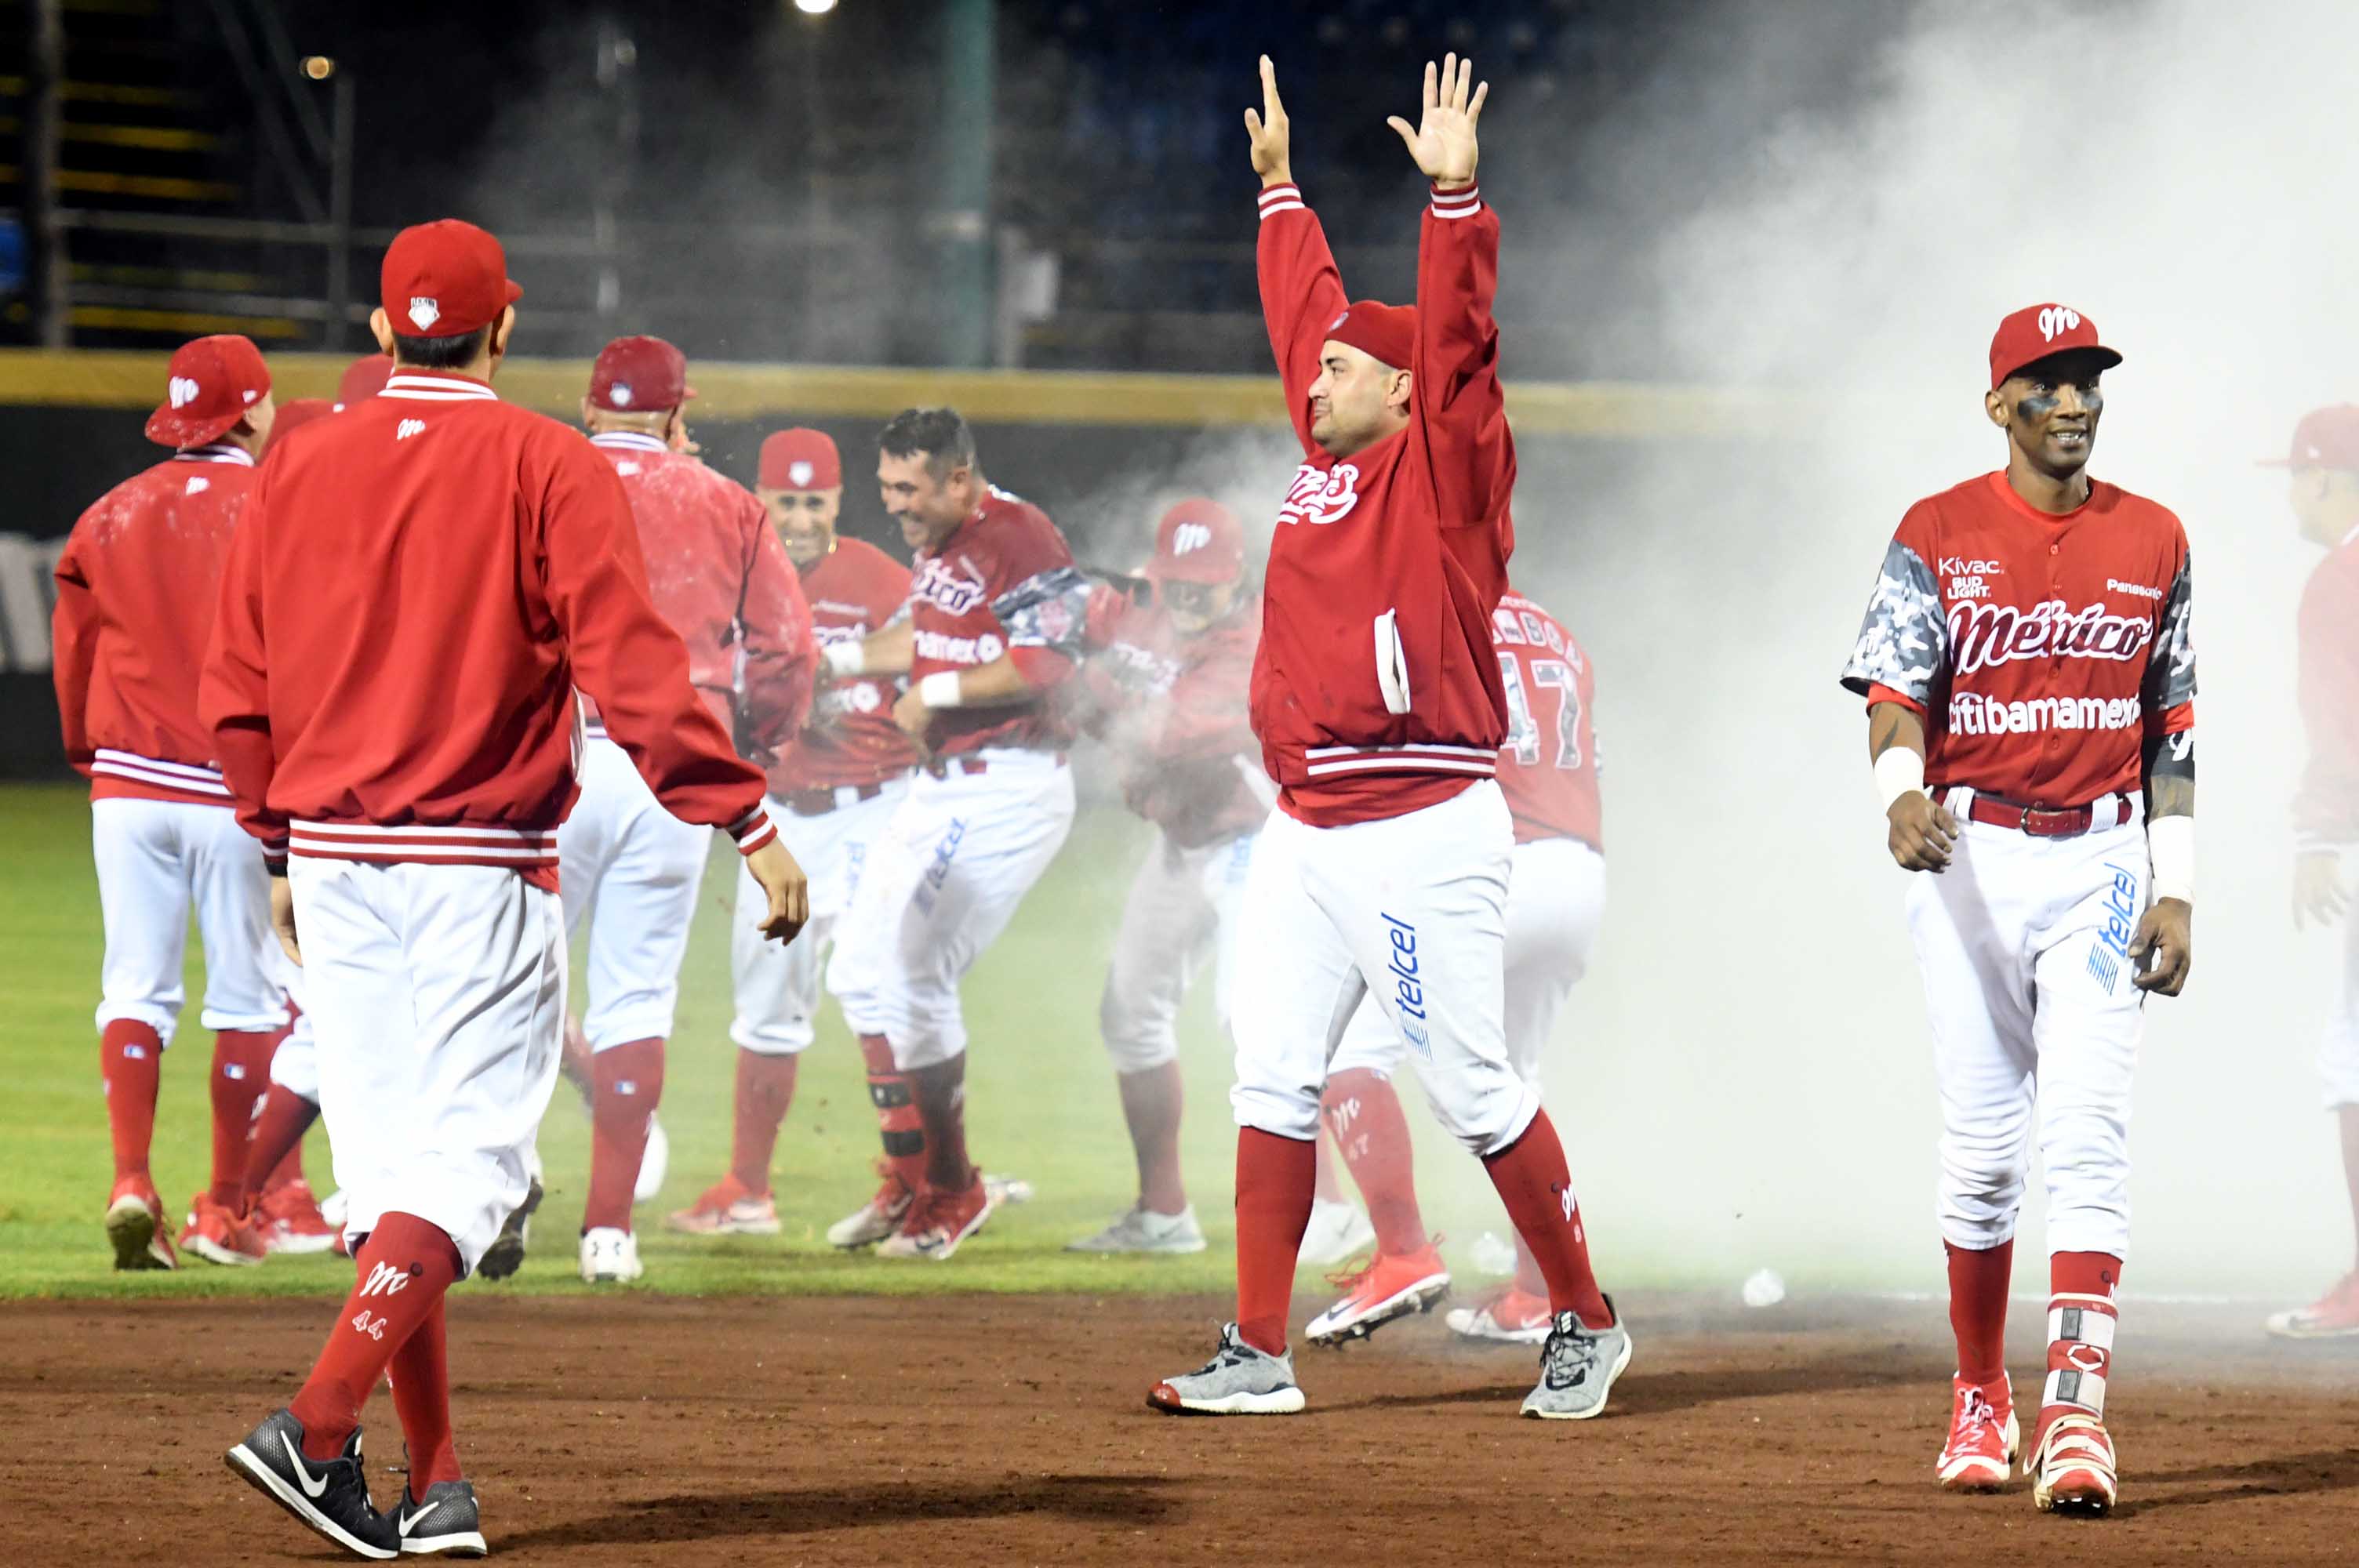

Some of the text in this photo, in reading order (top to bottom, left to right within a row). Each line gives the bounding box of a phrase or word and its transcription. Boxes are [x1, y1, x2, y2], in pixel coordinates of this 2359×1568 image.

[1947, 585, 1991, 601] LIGHT
[1952, 575, 1983, 590] BUD
[2106, 578, 2163, 601] Panasonic
[2096, 862, 2138, 958] telcel
[1380, 911, 1427, 1020] telcel
[352, 1309, 387, 1341] 44
